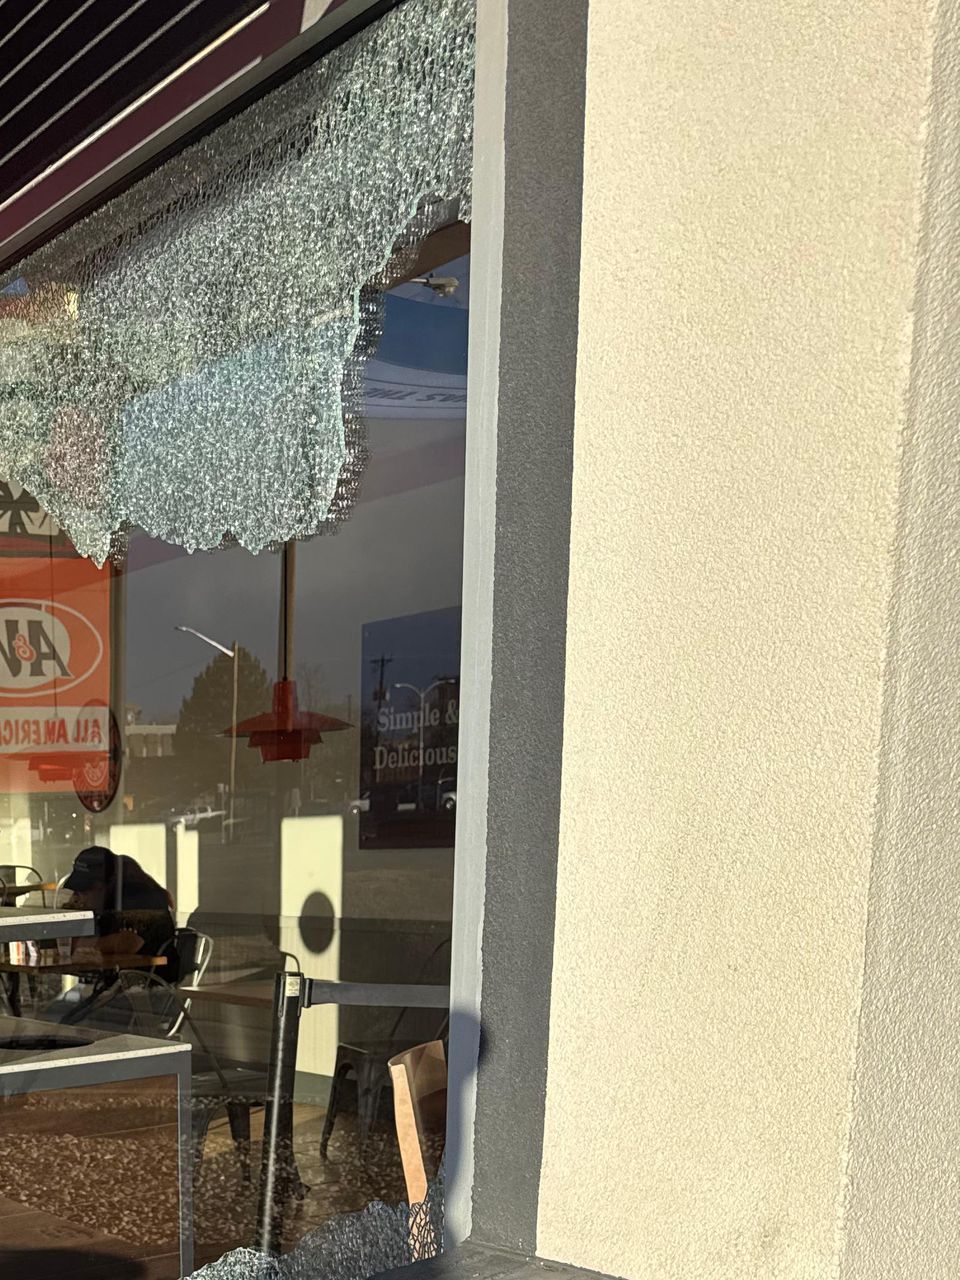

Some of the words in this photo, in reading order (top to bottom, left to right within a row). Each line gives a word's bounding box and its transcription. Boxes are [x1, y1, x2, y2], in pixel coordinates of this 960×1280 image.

[378, 702, 440, 733] Simple
[445, 700, 459, 724] &
[373, 746, 457, 769] Delicious
